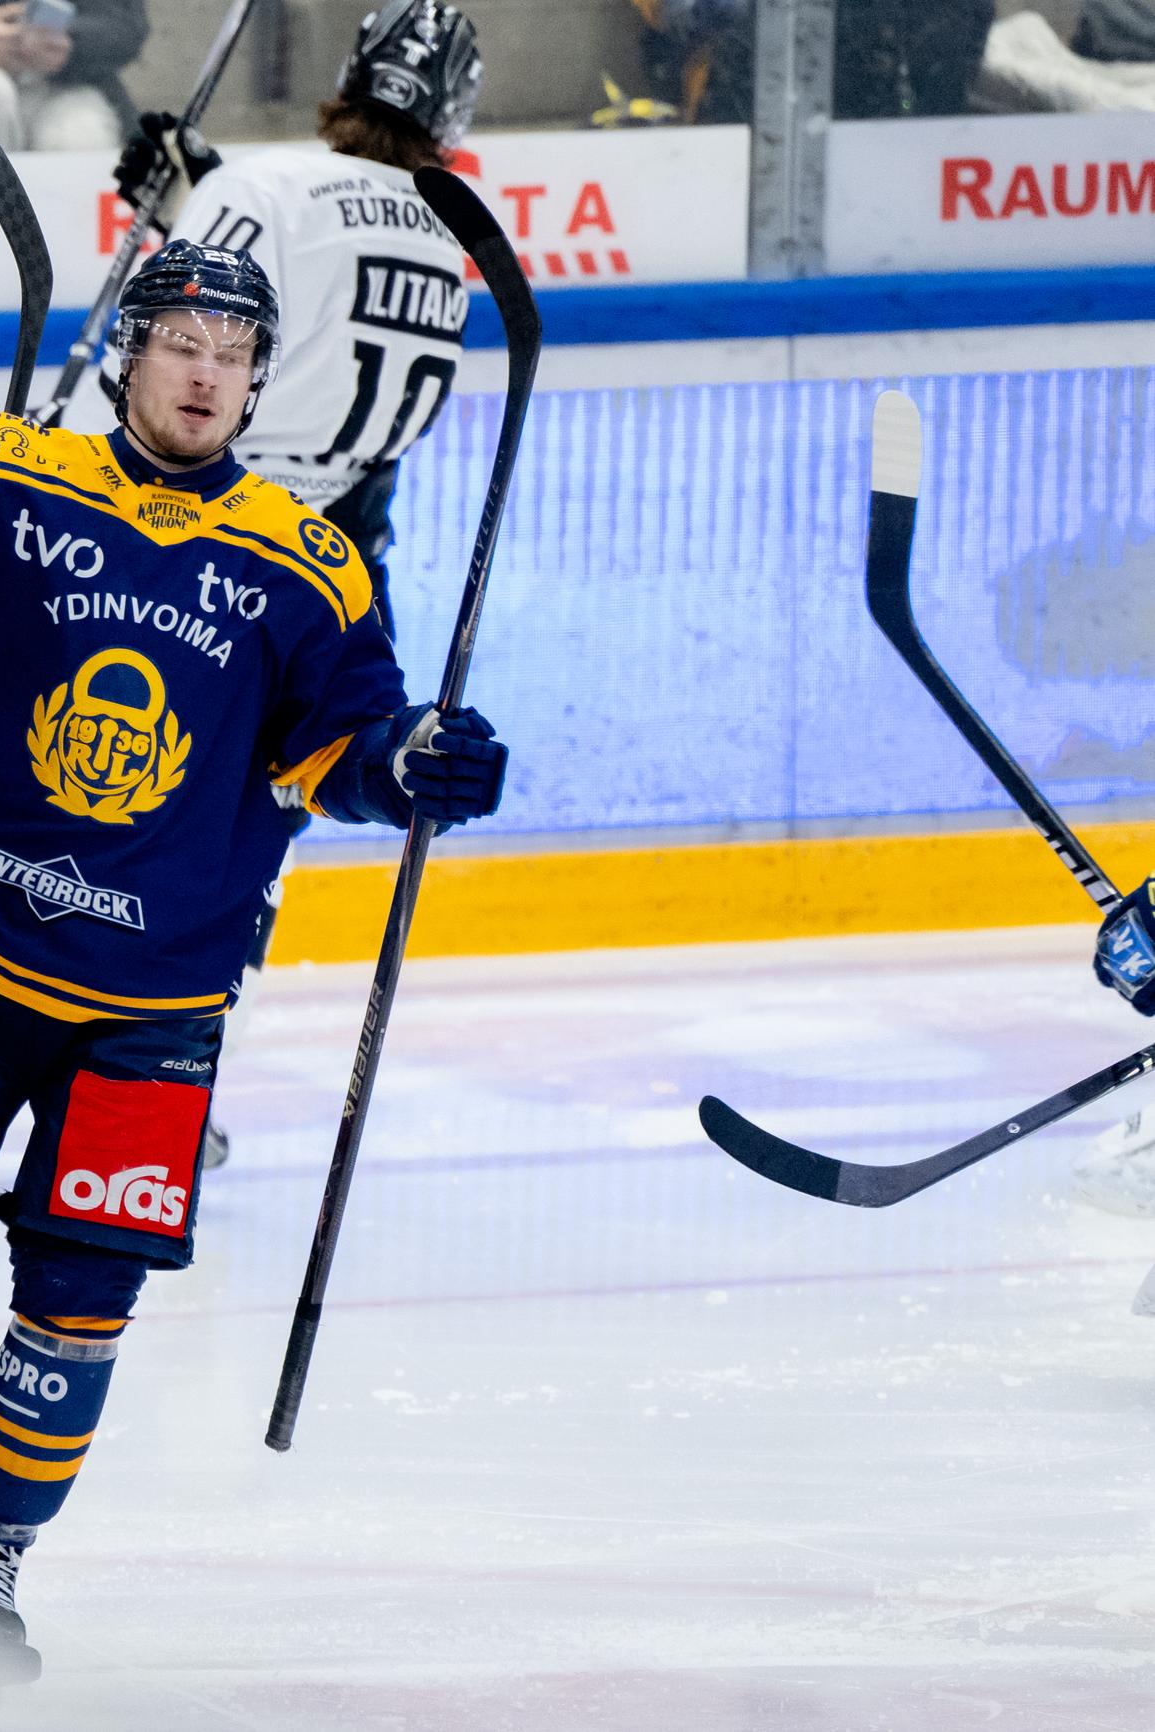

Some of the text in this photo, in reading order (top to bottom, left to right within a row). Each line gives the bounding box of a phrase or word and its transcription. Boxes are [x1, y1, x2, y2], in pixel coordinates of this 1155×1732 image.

[202, 249, 239, 266] 25
[200, 287, 260, 309] Pihlajalinna
[316, 339, 457, 467] 10
[99, 465, 127, 490] RTK
[137, 501, 202, 525] KAPTEENIN
[221, 491, 252, 510] RTK
[12, 508, 104, 578] tvo
[149, 516, 188, 531] HUONE
[197, 562, 267, 621] tvo
[42, 592, 234, 669] YDINVOIMA
[349, 981, 384, 1101] BAUER
[59, 1165, 187, 1227] oras
